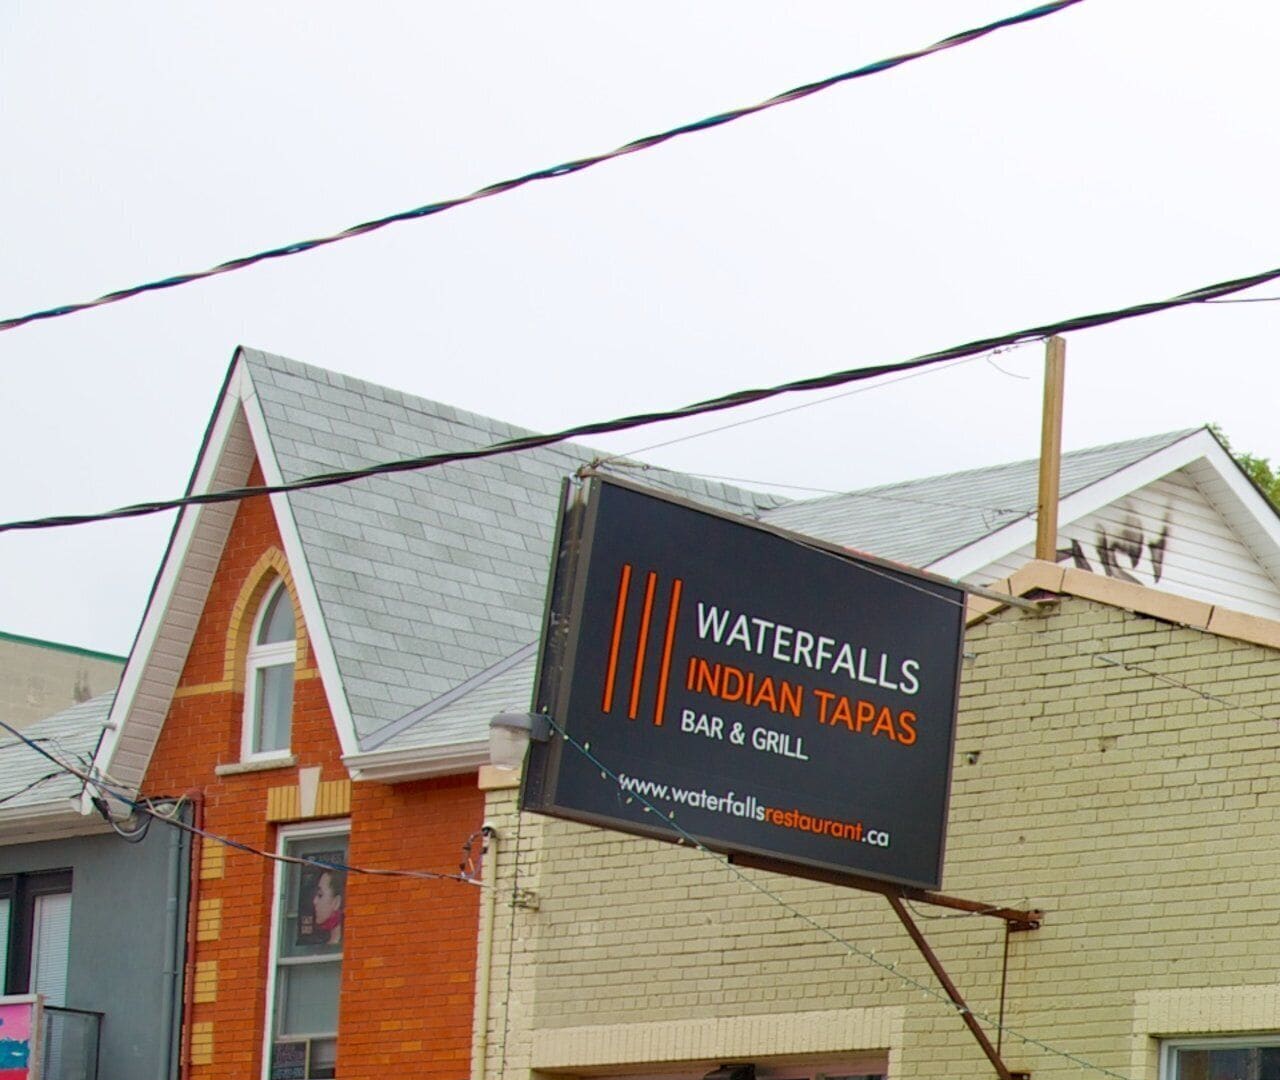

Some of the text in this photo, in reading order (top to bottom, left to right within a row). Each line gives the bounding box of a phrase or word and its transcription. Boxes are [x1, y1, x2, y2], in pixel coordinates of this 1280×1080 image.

[697, 602, 920, 695] WATERFALLS
[681, 710, 809, 761] BAR & GRILL
[687, 657, 918, 746] INDIAN TAPAS
[617, 773, 890, 848] www.waterfallsrestaurant.ca
